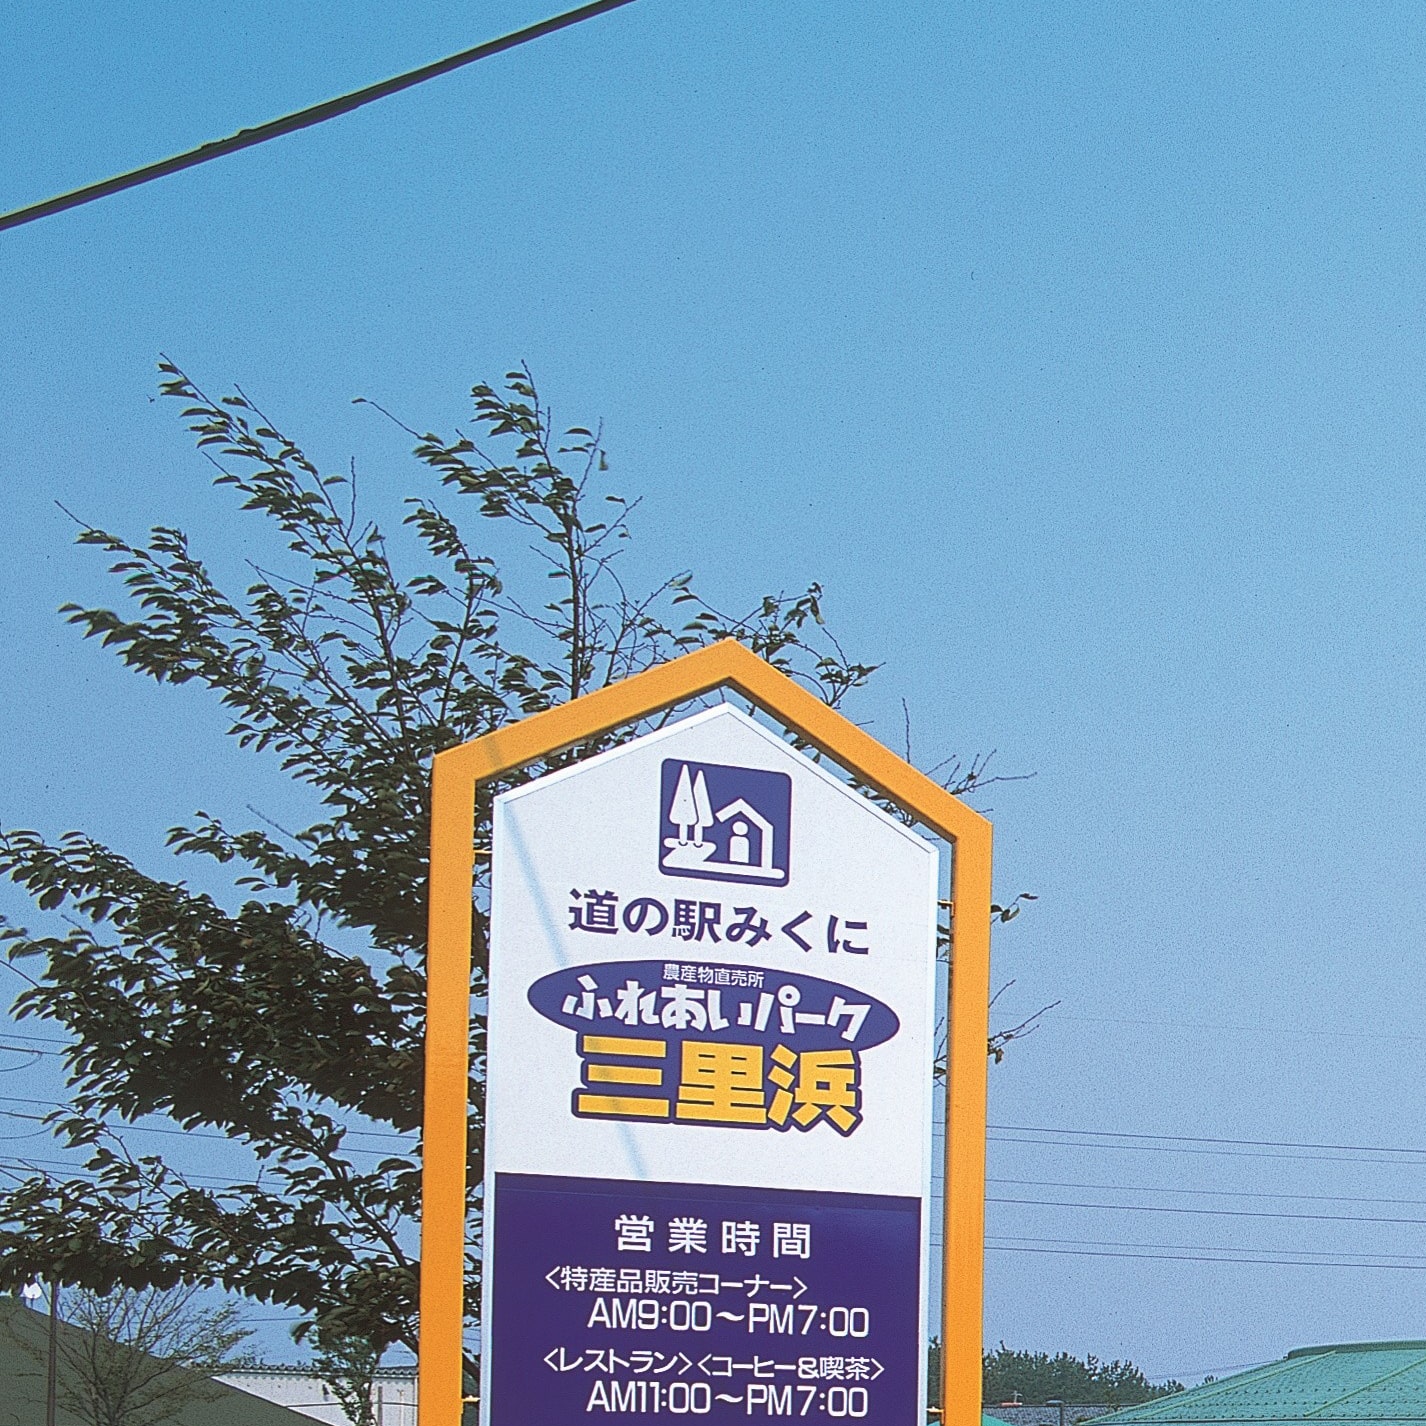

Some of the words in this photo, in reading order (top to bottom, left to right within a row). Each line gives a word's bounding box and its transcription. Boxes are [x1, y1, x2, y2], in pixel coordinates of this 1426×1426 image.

[567, 888, 870, 955] 道の駅みくに
[561, 974, 873, 1042] ふれあいパーク
[662, 963, 765, 988] 農産物直売所
[576, 1034, 859, 1133] 三里浜
[614, 1214, 812, 1259] 営業時間
